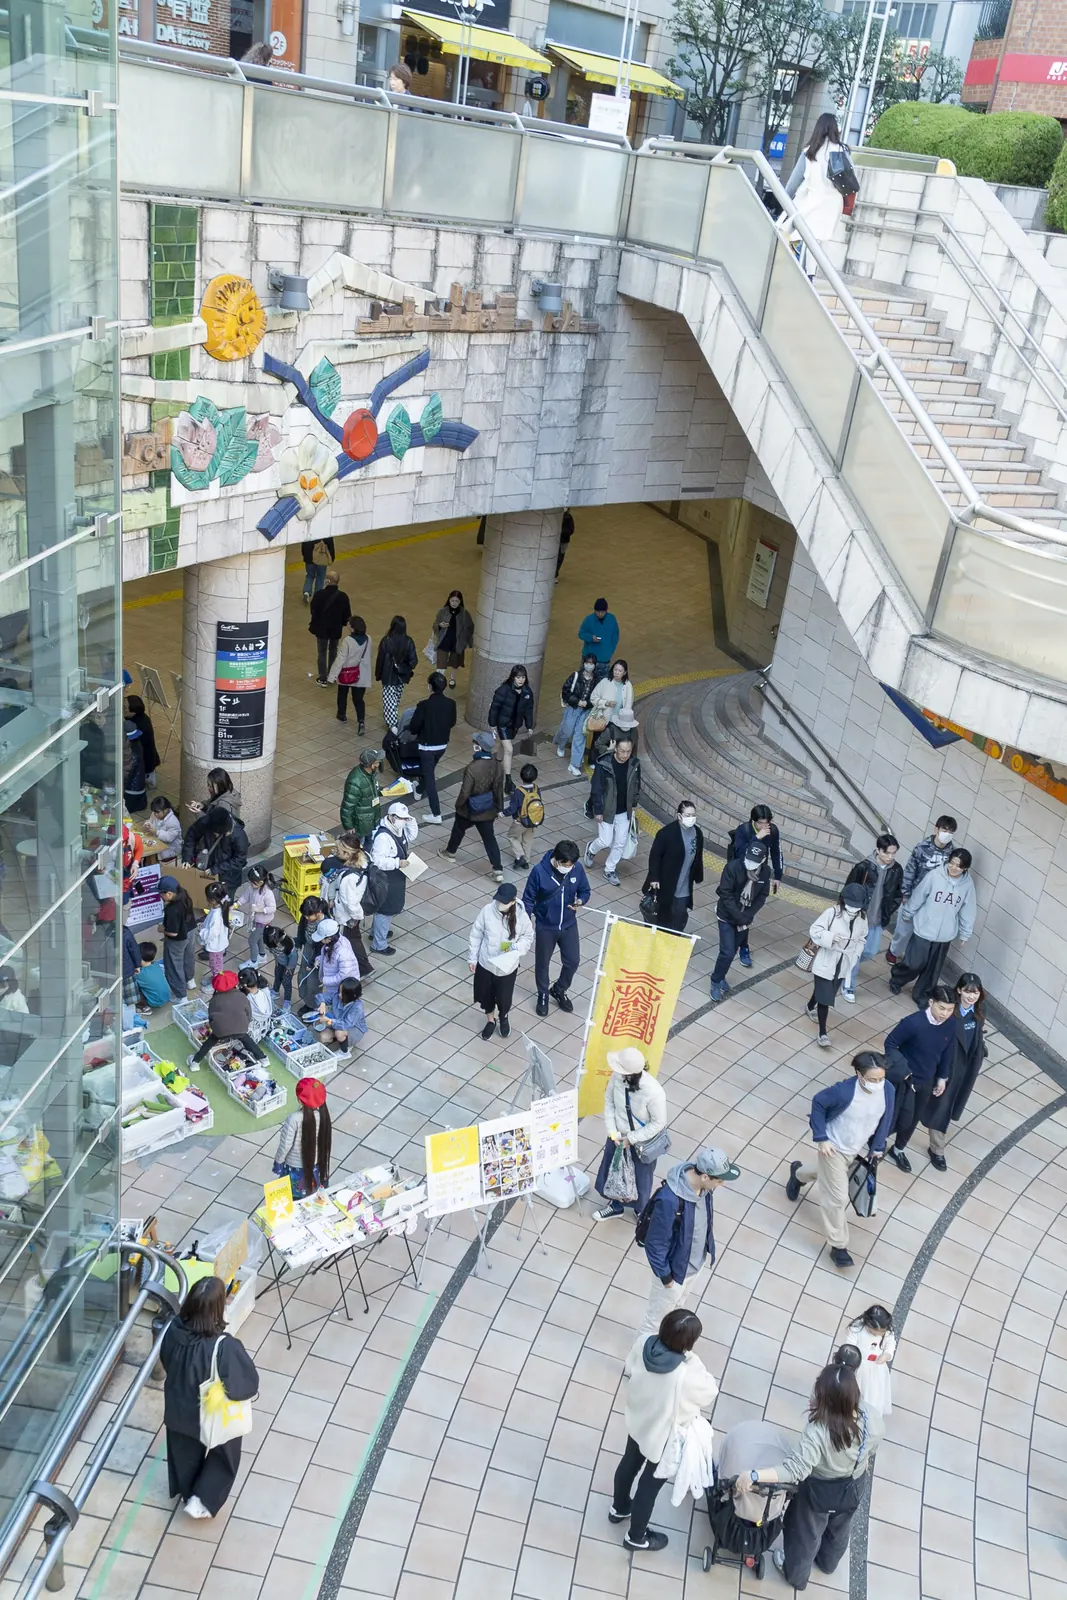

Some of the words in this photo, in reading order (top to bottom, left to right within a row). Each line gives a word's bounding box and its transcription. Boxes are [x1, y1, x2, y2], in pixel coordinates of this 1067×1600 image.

[176, 34, 211, 51] factory
[272, 36, 285, 50] 2F
[934, 891, 961, 907] GAP
